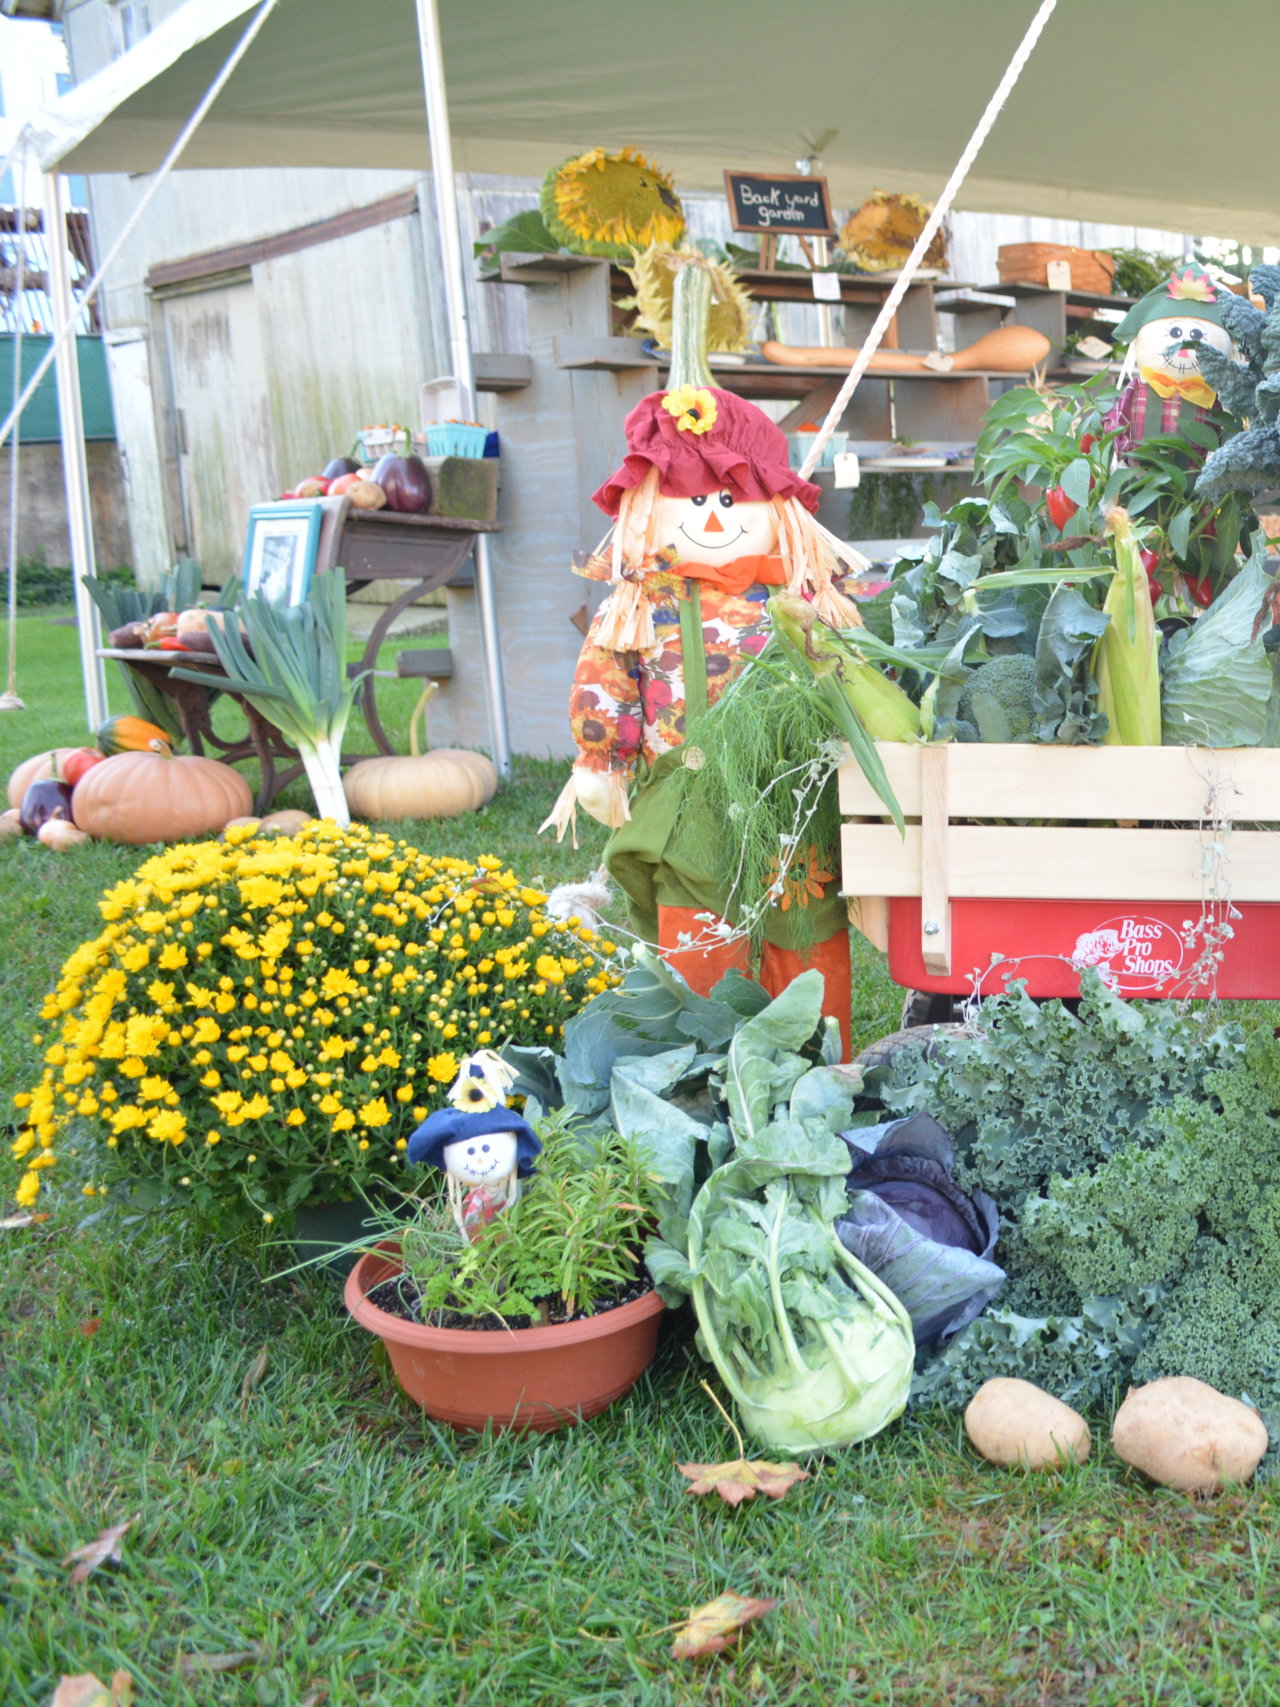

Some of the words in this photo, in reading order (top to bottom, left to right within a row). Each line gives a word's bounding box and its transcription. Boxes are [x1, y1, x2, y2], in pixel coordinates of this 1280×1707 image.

[785, 191, 819, 211] yard
[758, 206, 805, 226] garden
[1120, 919, 1162, 939] Bass
[1122, 938, 1152, 956] Pro
[1122, 955, 1173, 976] Shops
